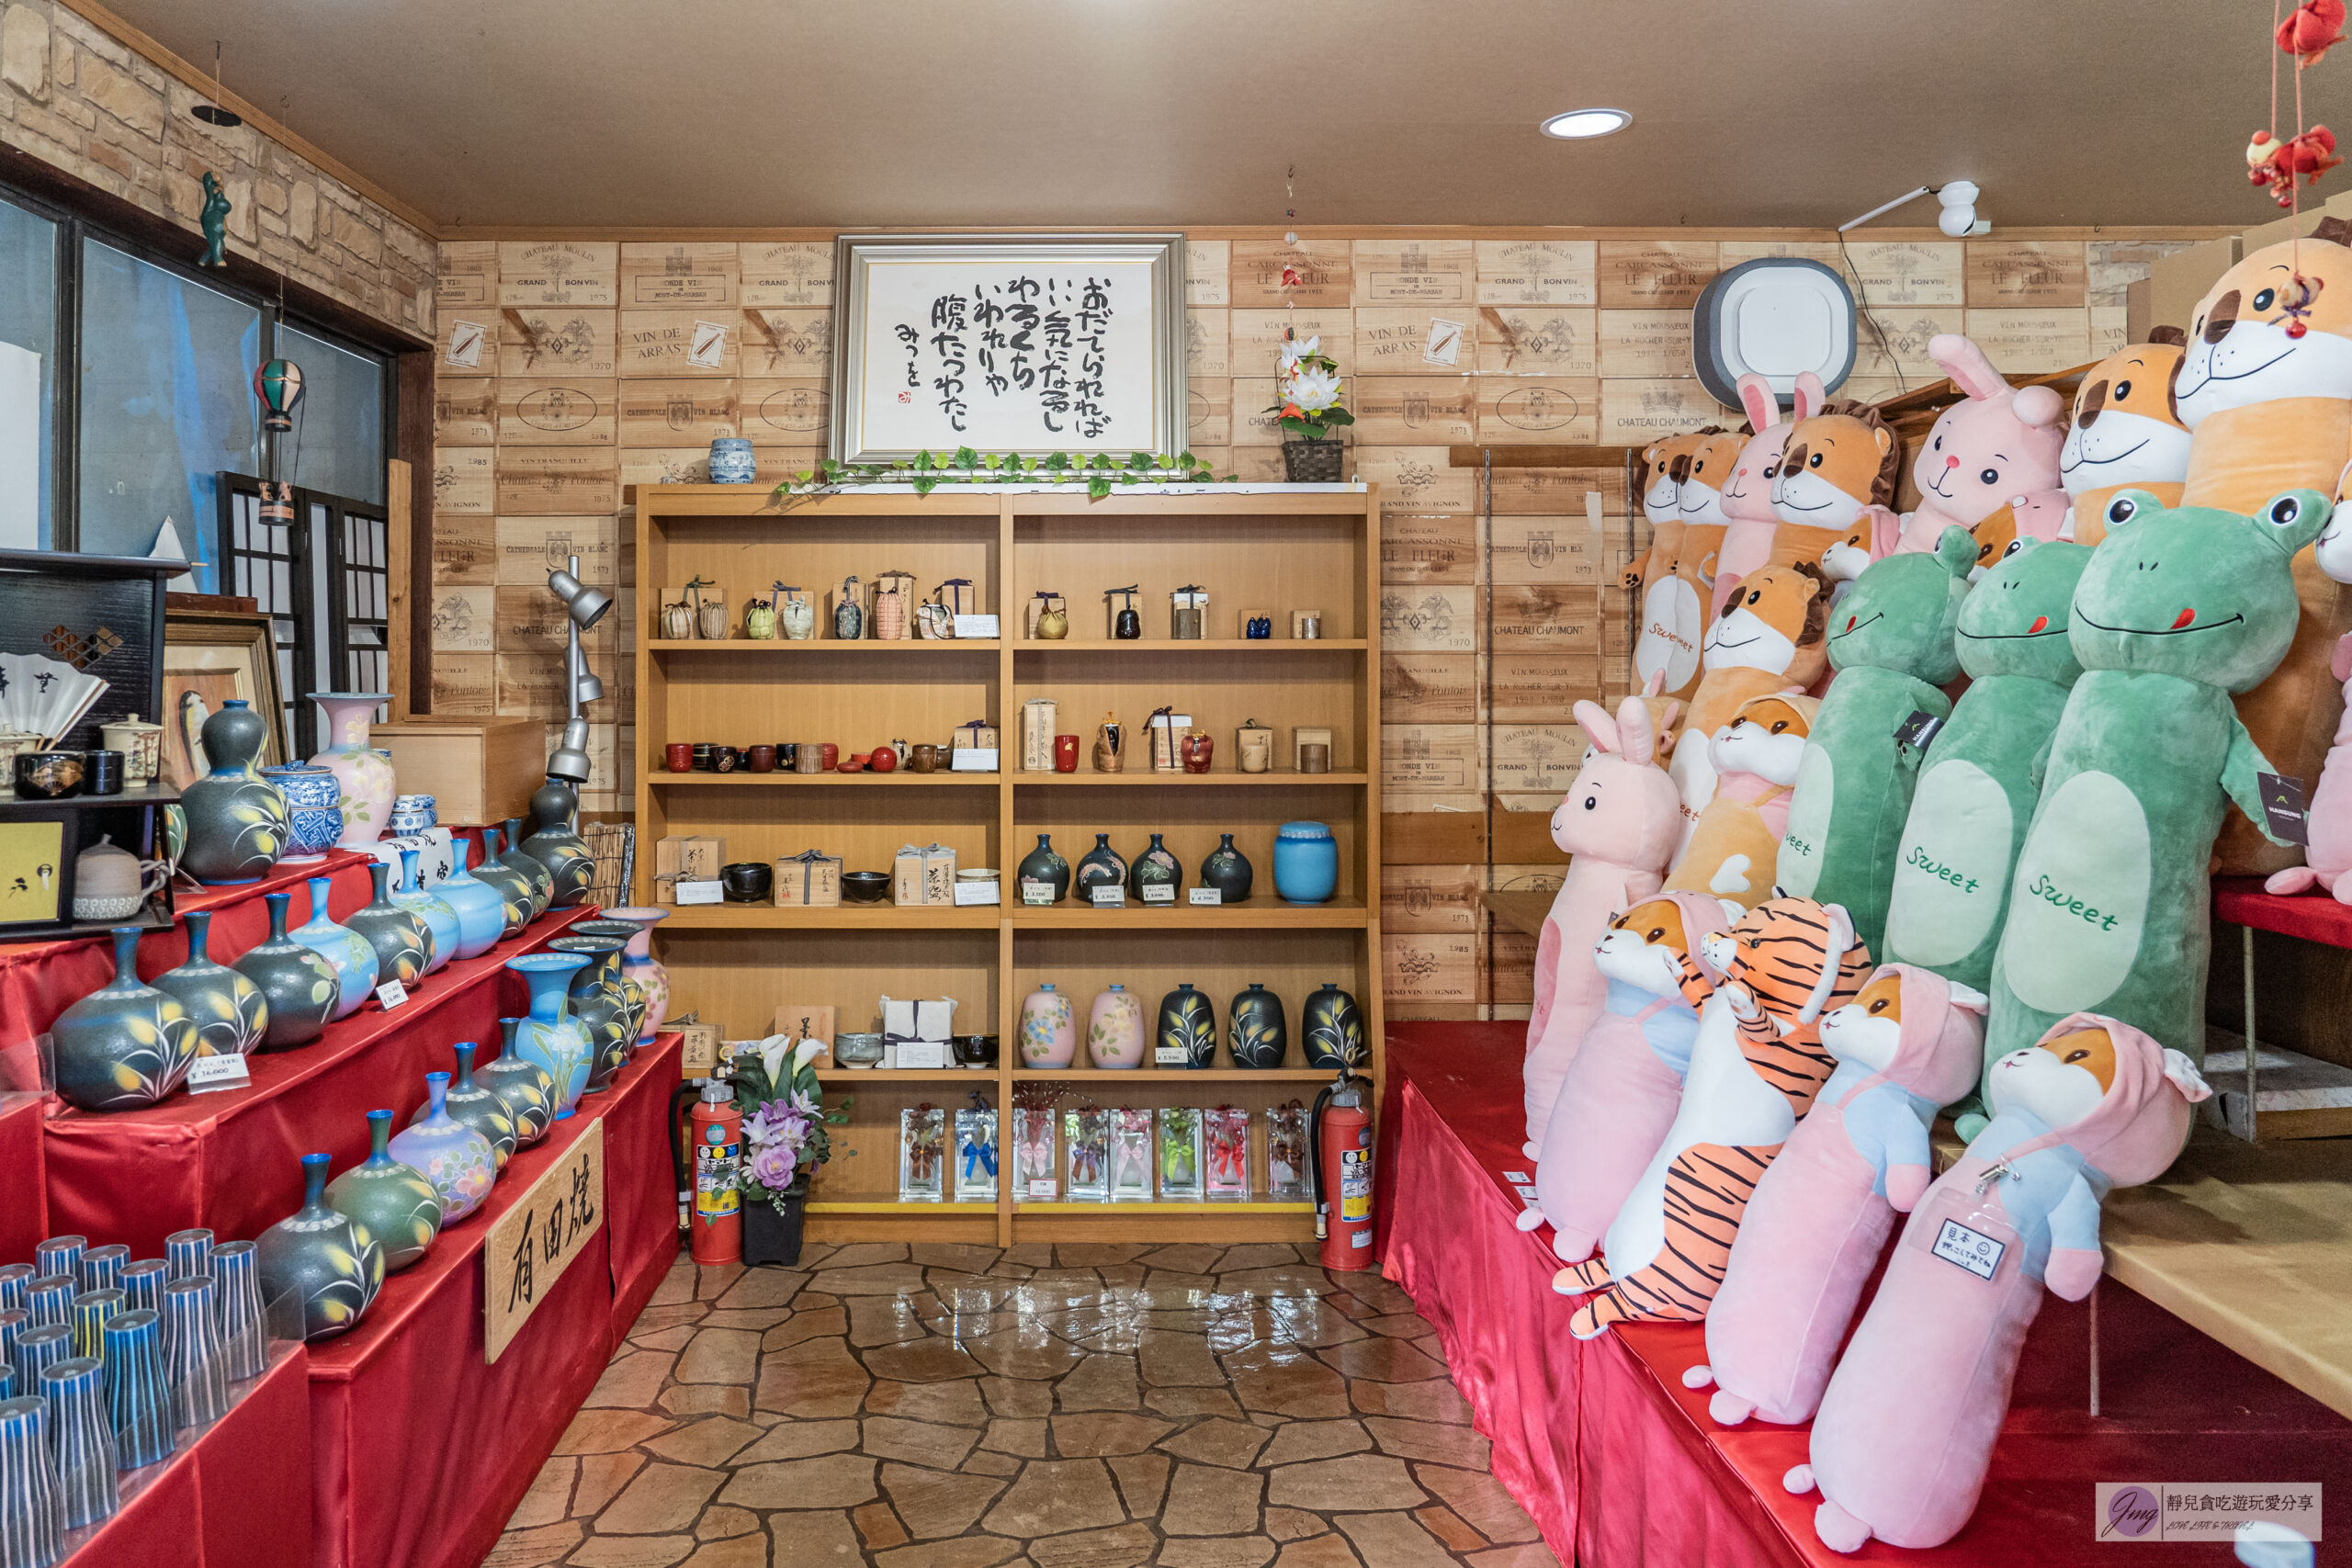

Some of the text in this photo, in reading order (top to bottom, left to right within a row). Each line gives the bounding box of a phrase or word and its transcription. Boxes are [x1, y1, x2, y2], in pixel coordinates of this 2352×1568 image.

[1257, 273, 1272, 284] LE
[1624, 274, 1640, 285] LE
[1991, 272, 2064, 285] LE FLEUR
[633, 328, 681, 344] VIN DE
[1004, 275, 1041, 391] わるくち
[1368, 325, 1417, 340] VIN DE
[638, 344, 681, 359] ARRAS
[894, 322, 921, 389] みつを
[1038, 277, 1072, 433] いい気になるし
[1373, 341, 1417, 355] ARRAS
[930, 292, 968, 433] 腹たつわたし
[1074, 276, 1114, 439] おだてられれば
[1617, 418, 1657, 426] CHATEAU
[1412, 550, 1455, 561] FLEUR
[513, 626, 551, 634] CHATEAU
[1494, 626, 1585, 635] CHATEAU CHAUMONT
[1448, 638, 1471, 647] 1970
[1545, 729, 1577, 747] MOULIN
[1905, 845, 1980, 896] Sweet
[2029, 874, 2120, 934] Sweet
[1947, 1226, 1971, 1243] 見本
